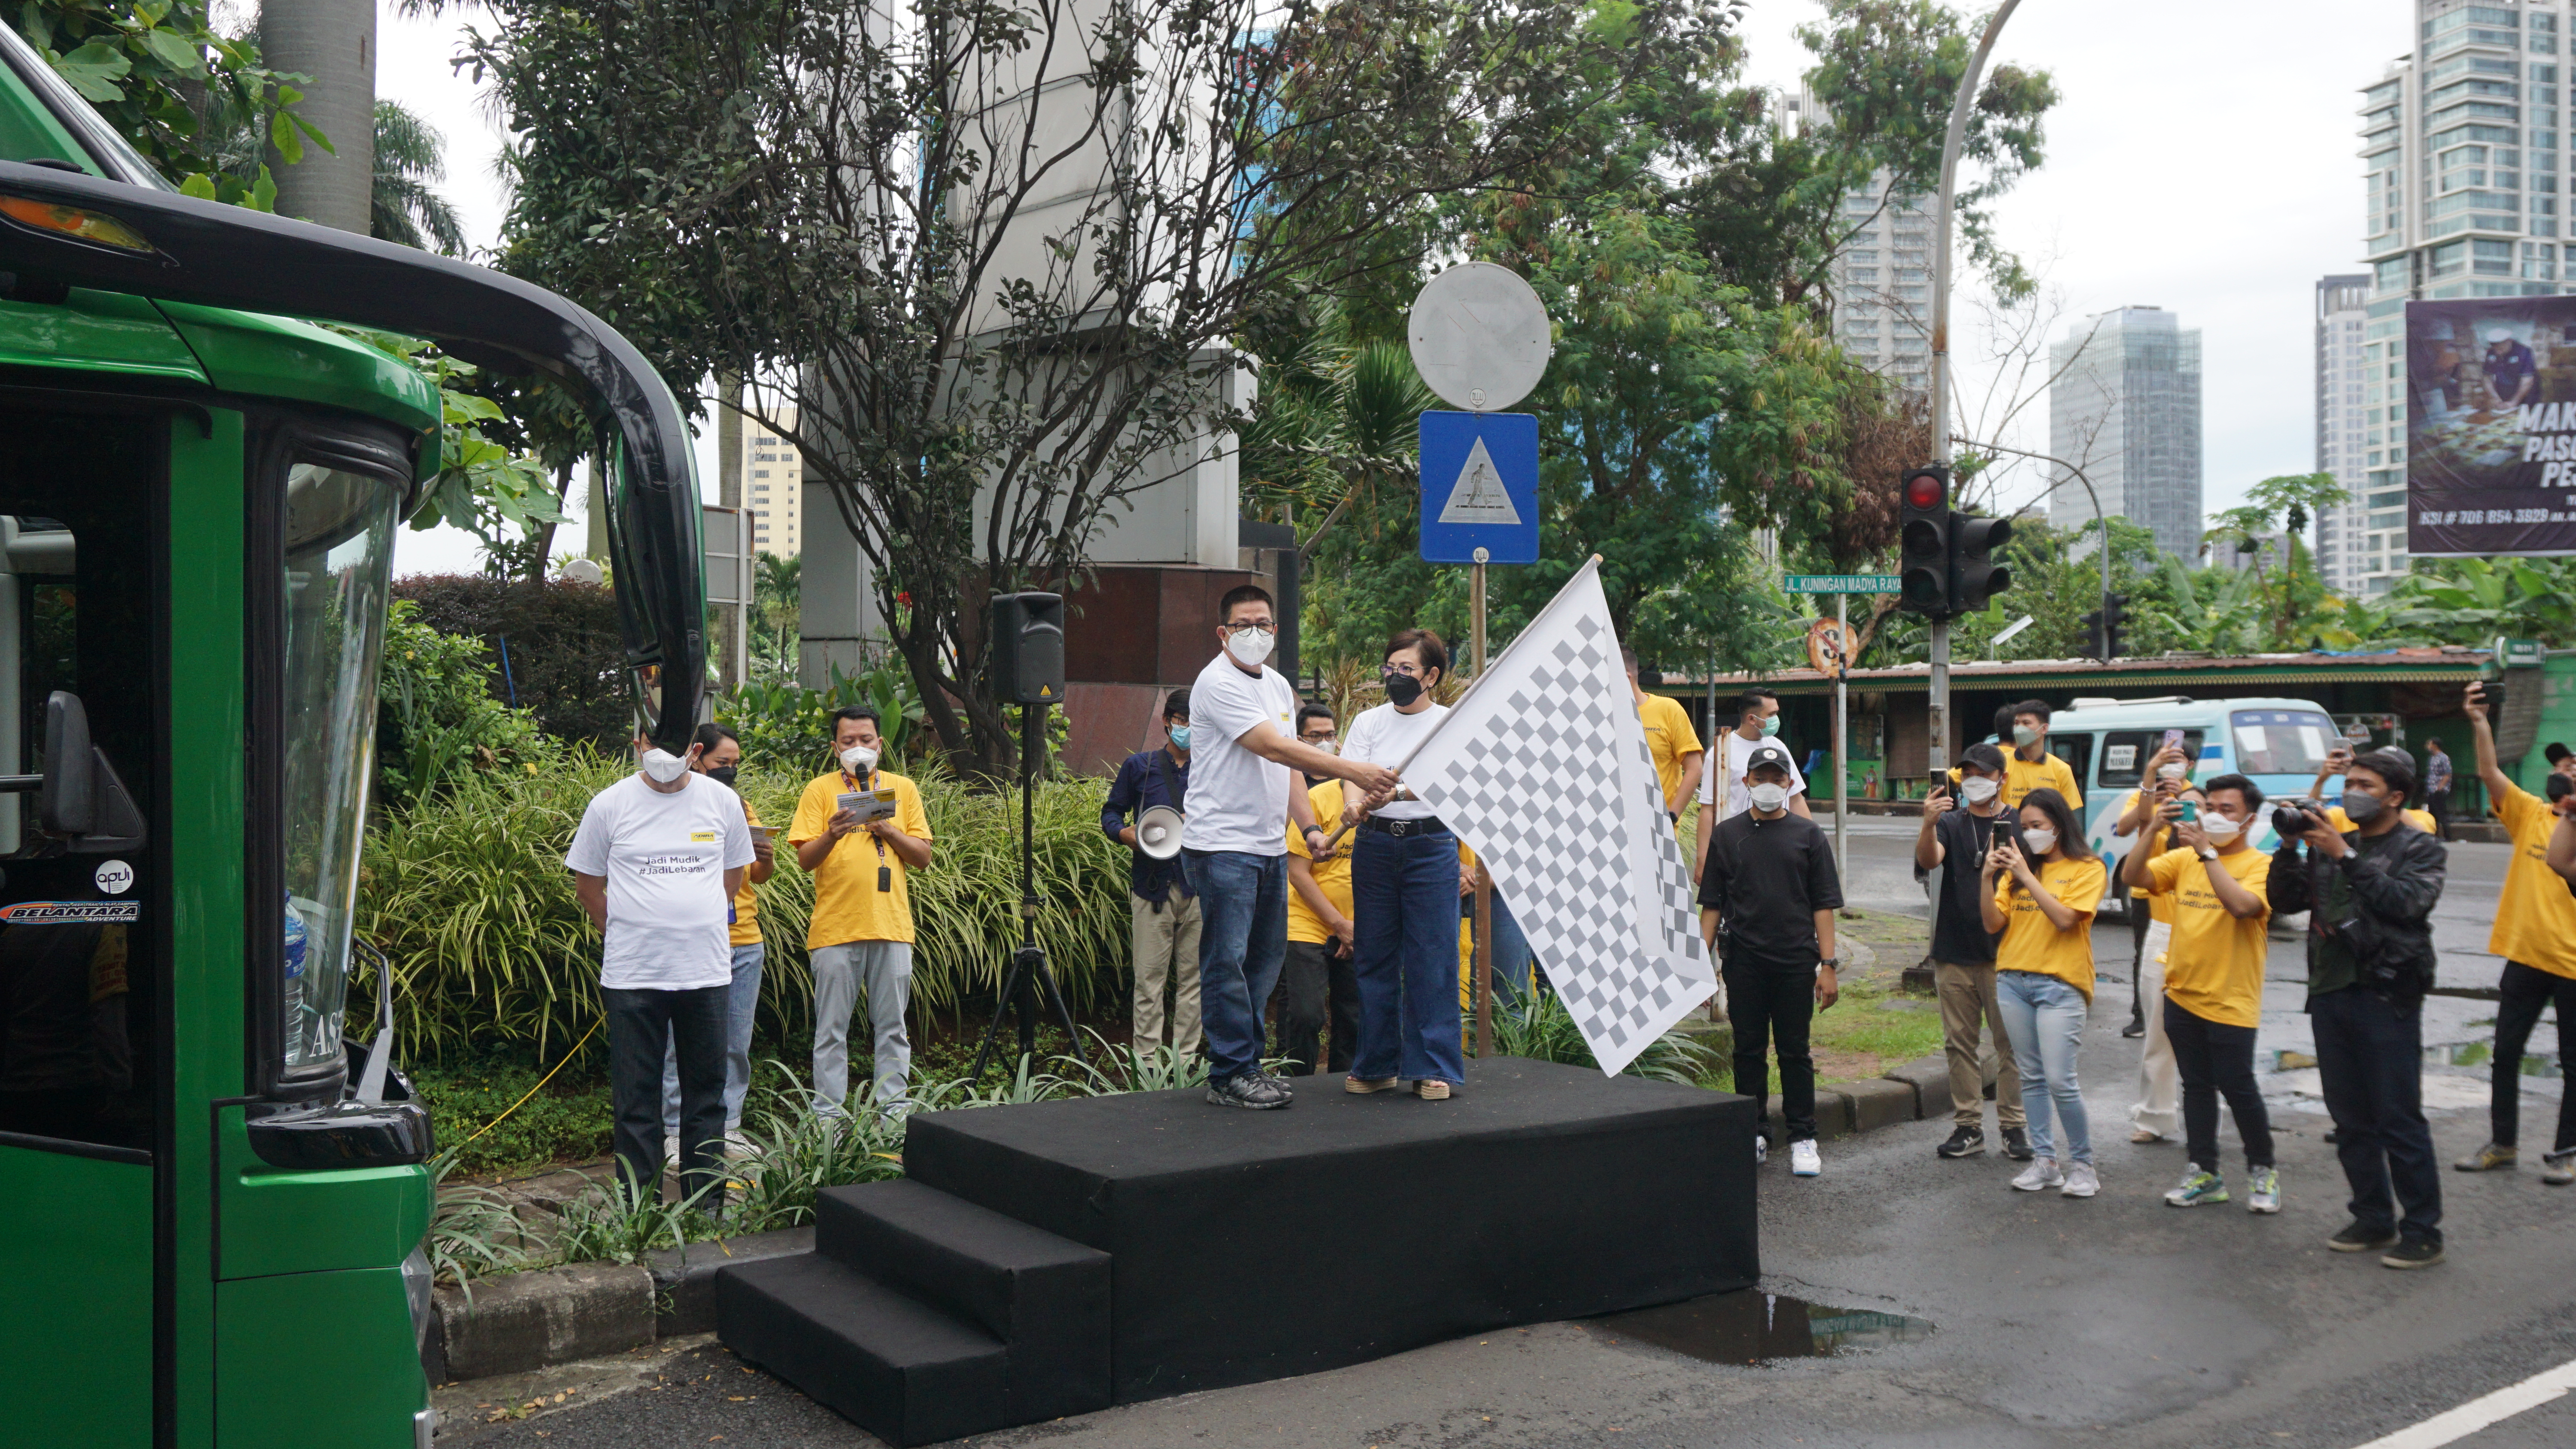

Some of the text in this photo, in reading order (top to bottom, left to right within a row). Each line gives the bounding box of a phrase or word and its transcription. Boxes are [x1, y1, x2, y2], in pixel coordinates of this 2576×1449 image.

[1786, 577, 1902, 591] JL. KUNINGAN MADYA RAYA
[645, 856, 667, 864] Jadi
[639, 866, 706, 875] #JadiLebaran
[8, 906, 138, 919] BELANTARA
